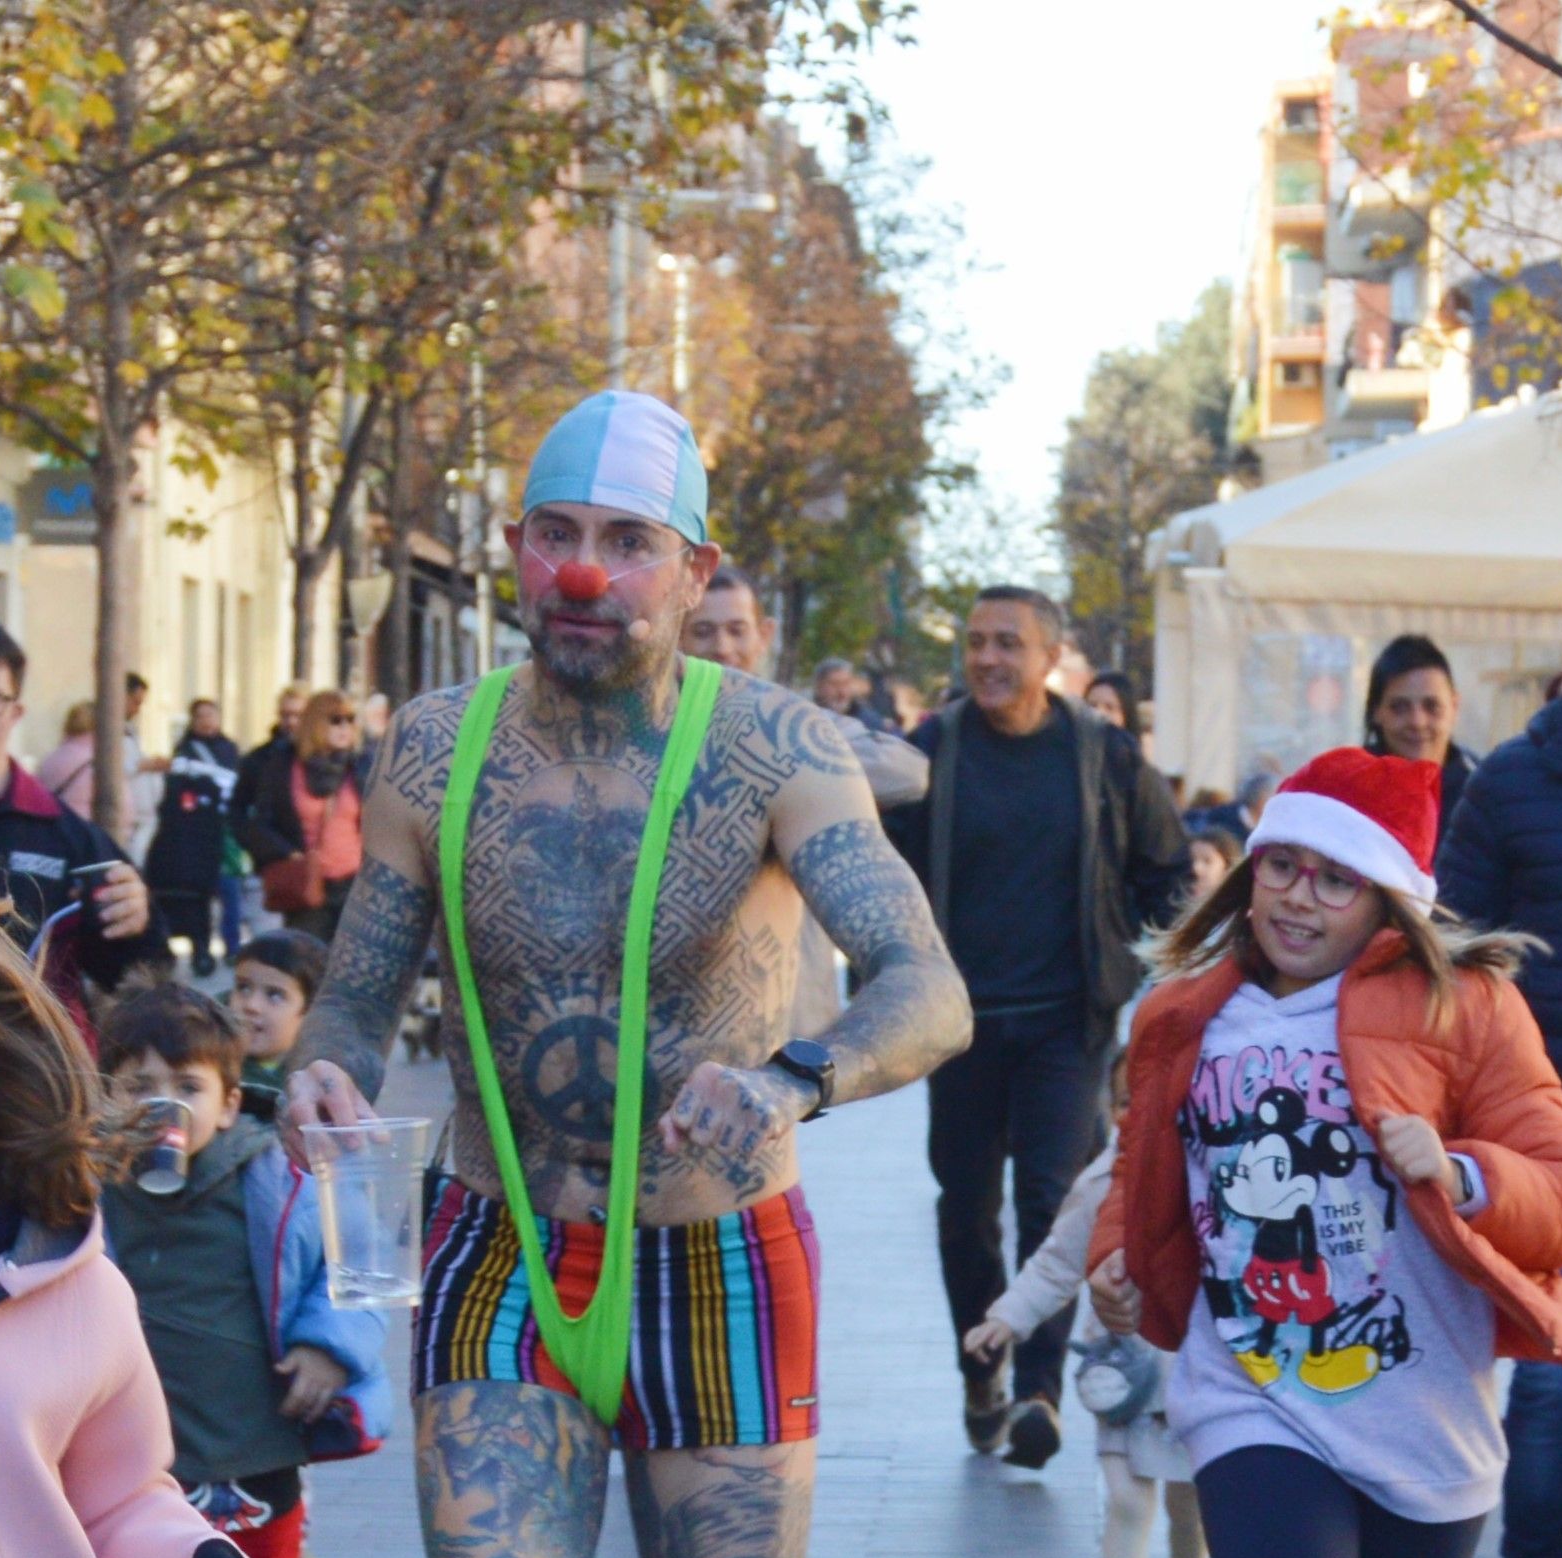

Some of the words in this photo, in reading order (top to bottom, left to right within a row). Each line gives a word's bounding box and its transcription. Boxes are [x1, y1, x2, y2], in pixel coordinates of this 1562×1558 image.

[1190, 1044, 1352, 1127] MICKE
[1320, 1201, 1362, 1218] THIS
[1319, 1223, 1335, 1239] IS
[1340, 1220, 1366, 1238] MY
[1326, 1239, 1366, 1256] VIBE
